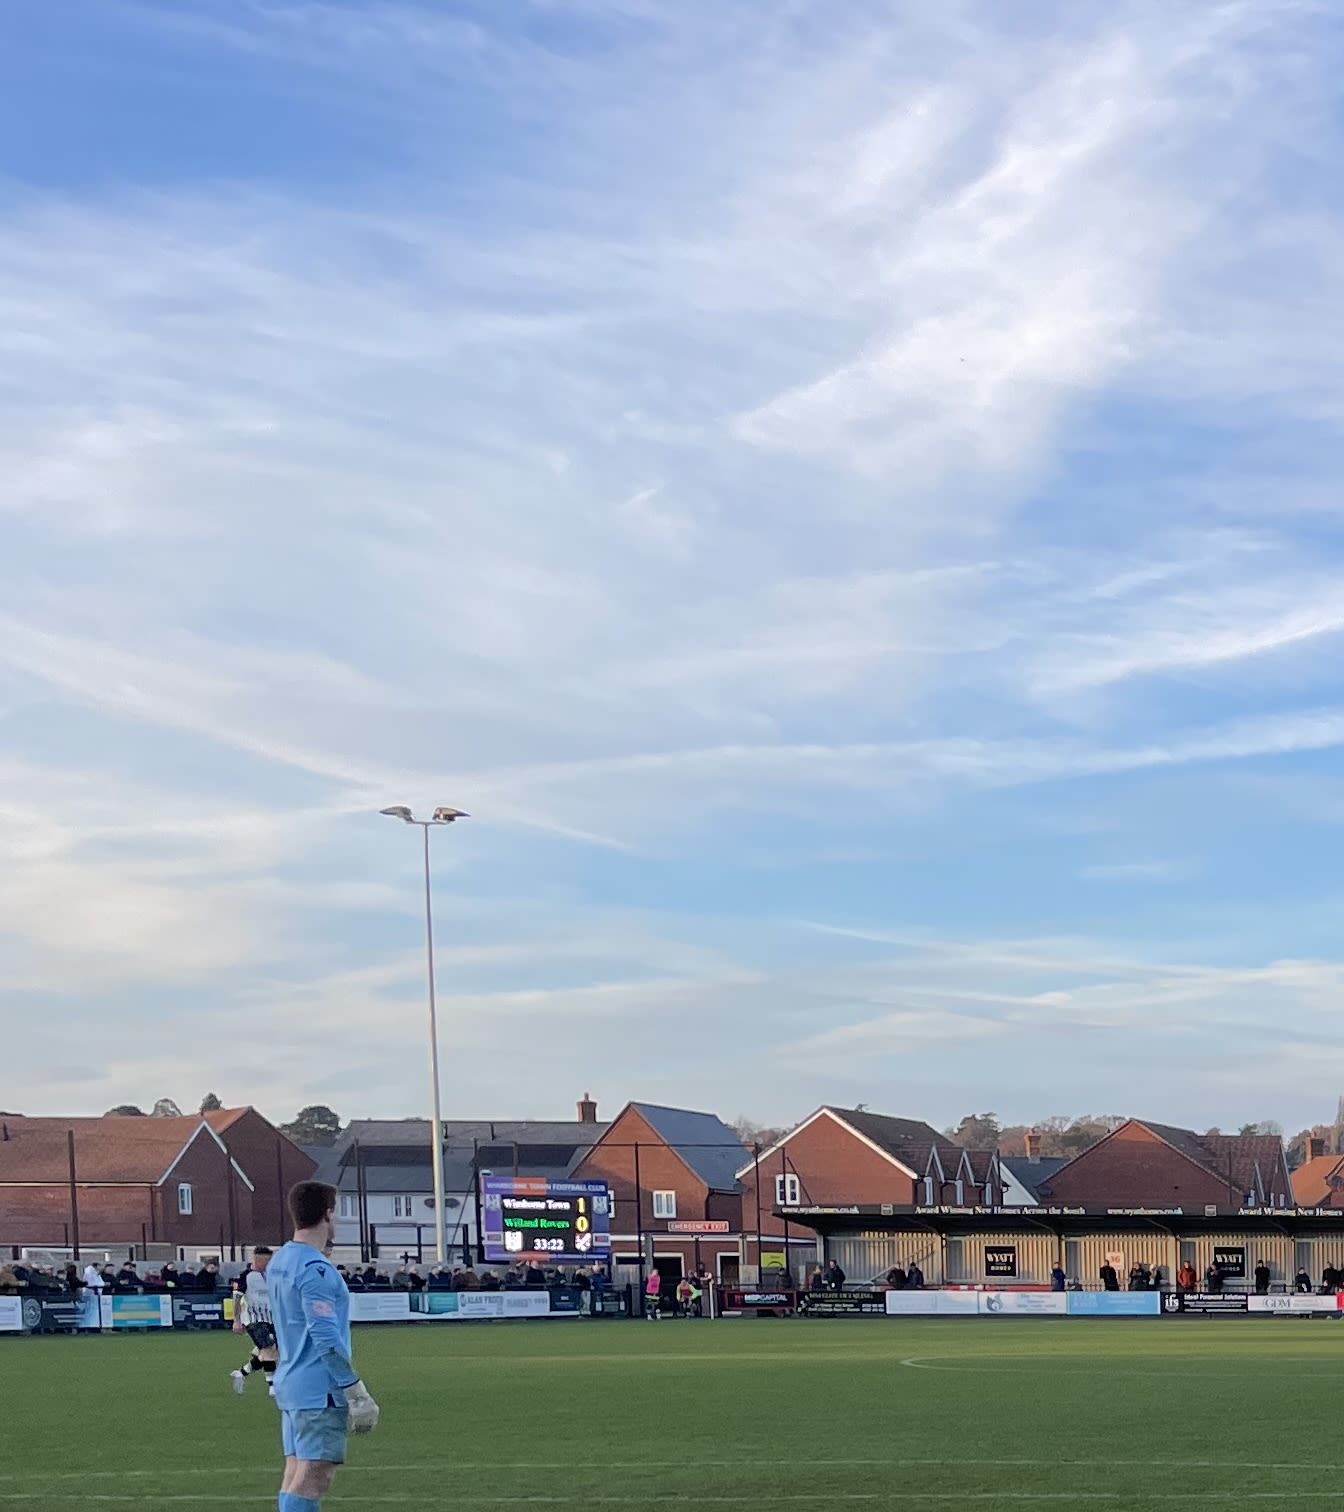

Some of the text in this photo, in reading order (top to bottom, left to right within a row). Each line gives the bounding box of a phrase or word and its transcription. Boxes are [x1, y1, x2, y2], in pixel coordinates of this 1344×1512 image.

[552, 1183, 586, 1191] FOOTBALL
[587, 1184, 606, 1192] CLUB
[503, 1199, 570, 1210] Wimborne Town
[577, 1197, 585, 1213] 1
[915, 1205, 939, 1214] Award
[975, 1205, 992, 1214] New
[1022, 1205, 1047, 1214] Across
[1049, 1205, 1061, 1214] the
[1063, 1205, 1085, 1214] South
[1238, 1207, 1261, 1216] Award
[1297, 1207, 1314, 1216] New
[504, 1218, 569, 1229] Willand Rovers
[575, 1216, 589, 1232] 0
[533, 1238, 564, 1251] 33:22
[986, 1253, 1015, 1262] WYATT
[1216, 1254, 1243, 1263] WYATT
[1165, 1294, 1179, 1306] ifs
